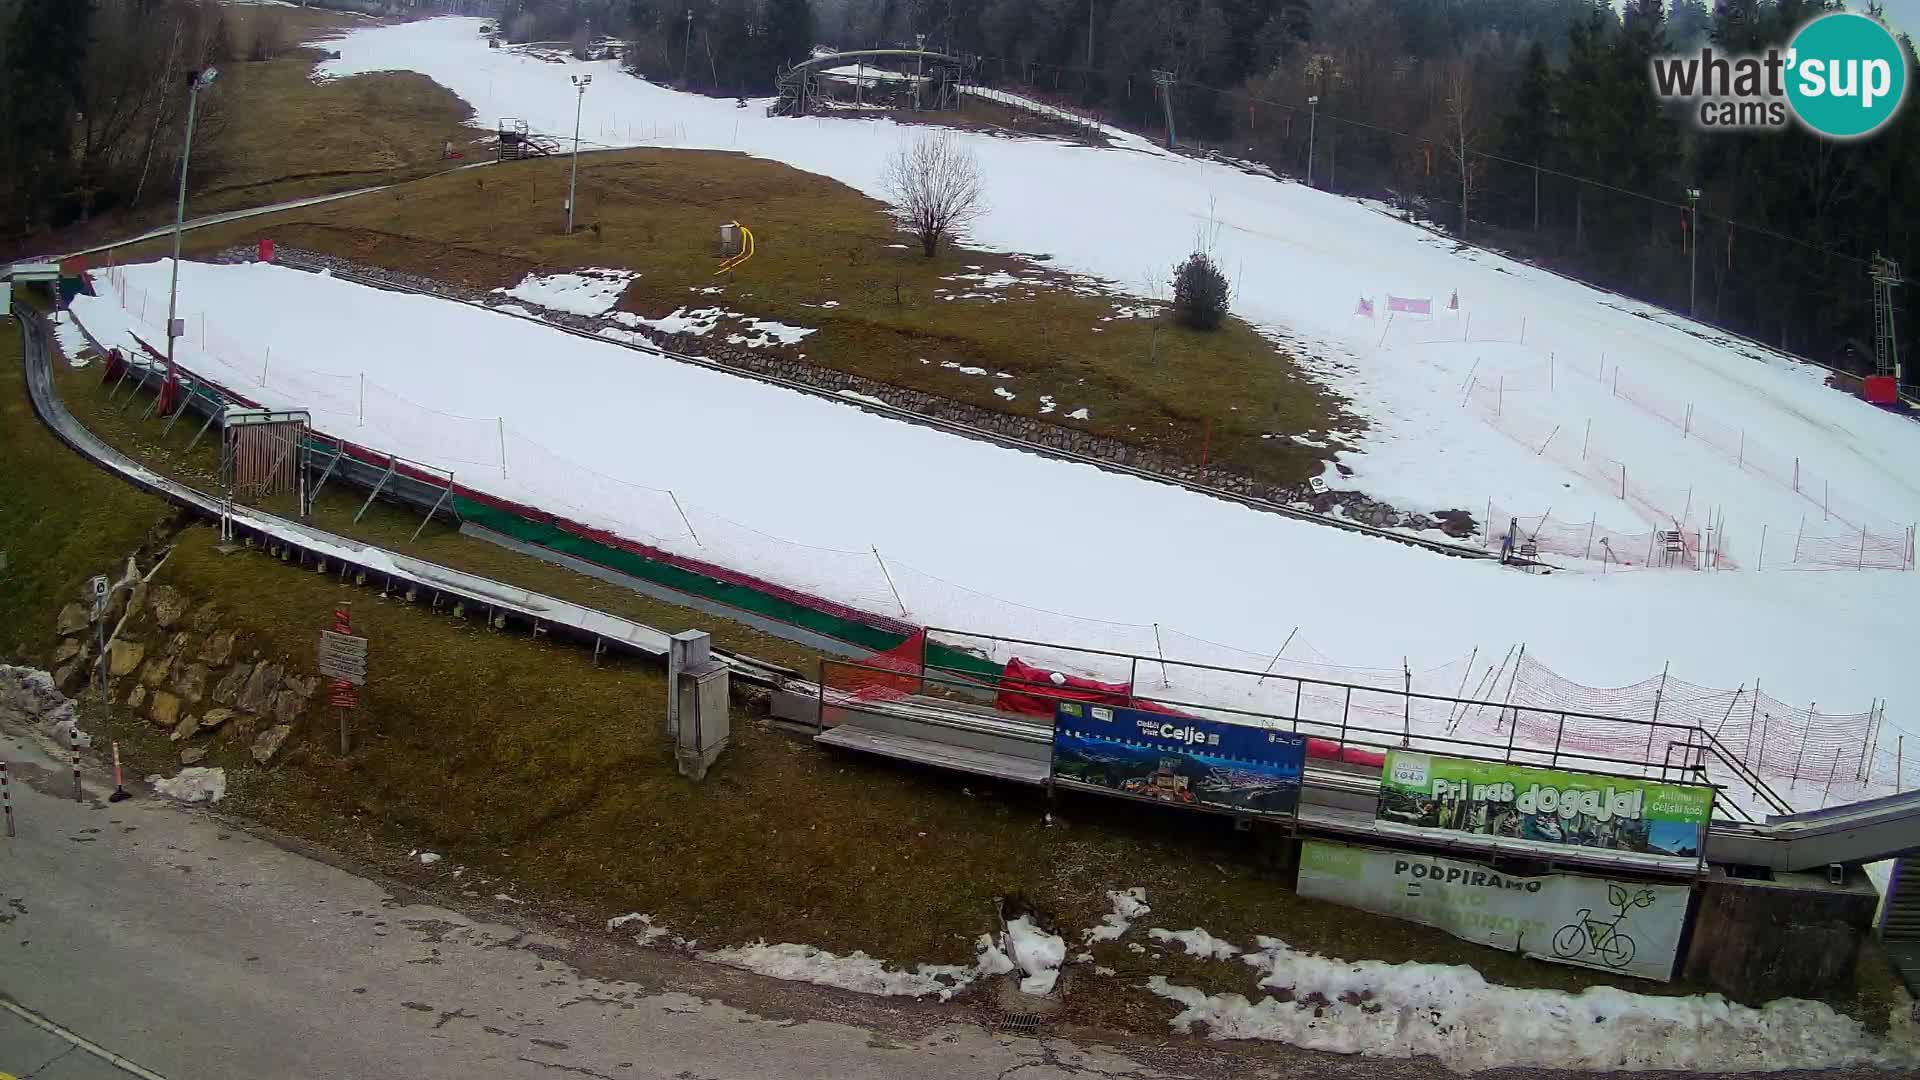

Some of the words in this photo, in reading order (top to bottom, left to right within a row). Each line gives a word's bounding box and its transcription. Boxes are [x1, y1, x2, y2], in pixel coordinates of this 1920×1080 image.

[1160, 723, 1206, 745] Celje
[1431, 777, 1469, 801] Pri
[1472, 782, 1515, 803] nas
[1394, 860, 1542, 893] PODPIRAMO
